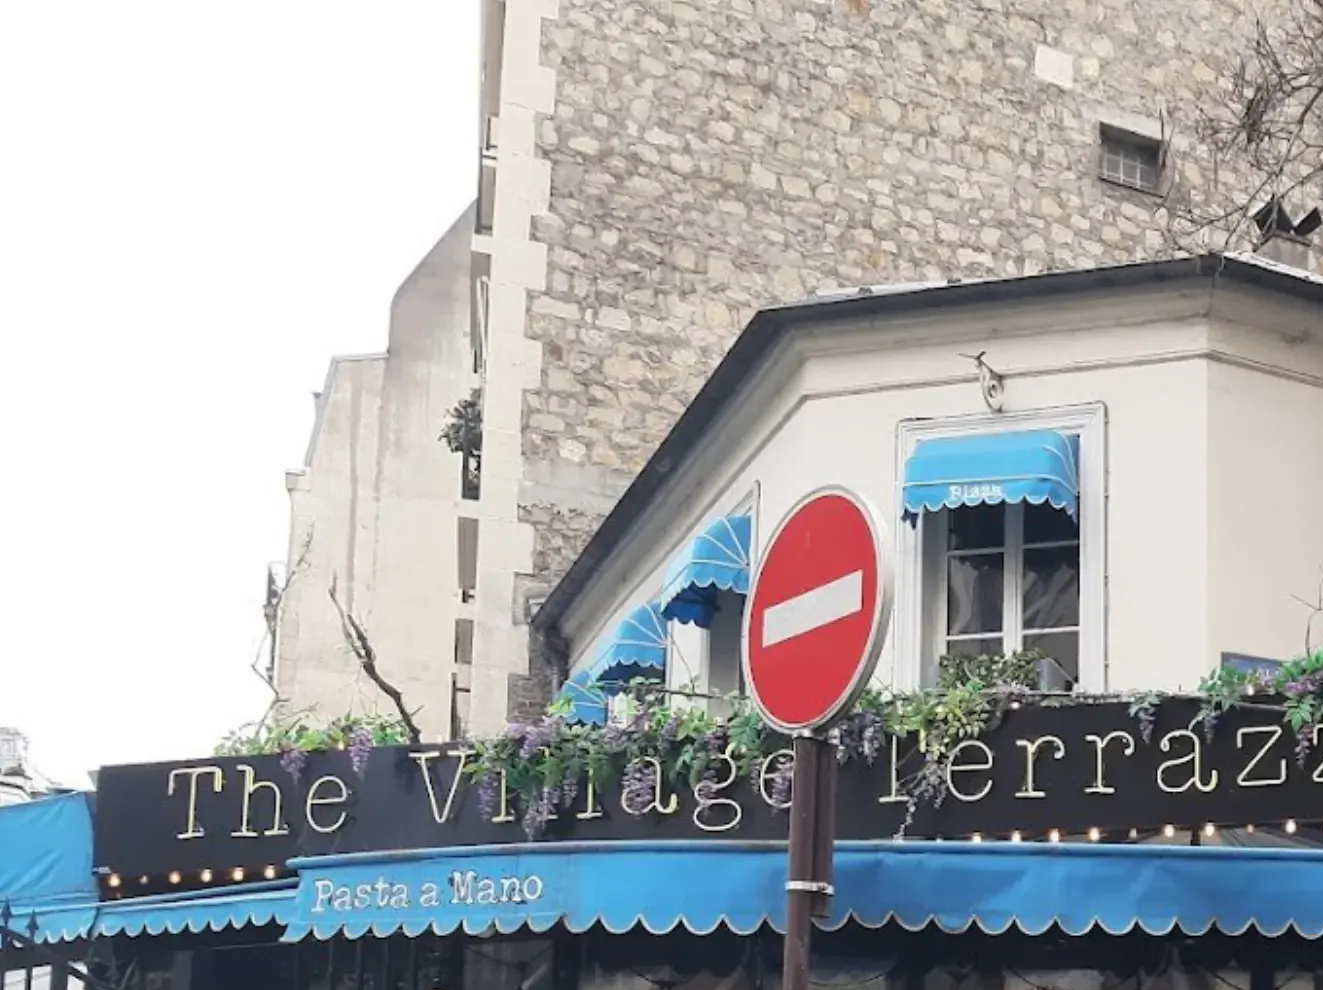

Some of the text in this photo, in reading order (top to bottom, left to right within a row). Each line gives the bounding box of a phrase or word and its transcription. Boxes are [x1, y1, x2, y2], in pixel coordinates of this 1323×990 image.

[168, 763, 349, 840] The
[311, 870, 544, 913] Pasta a Mano
